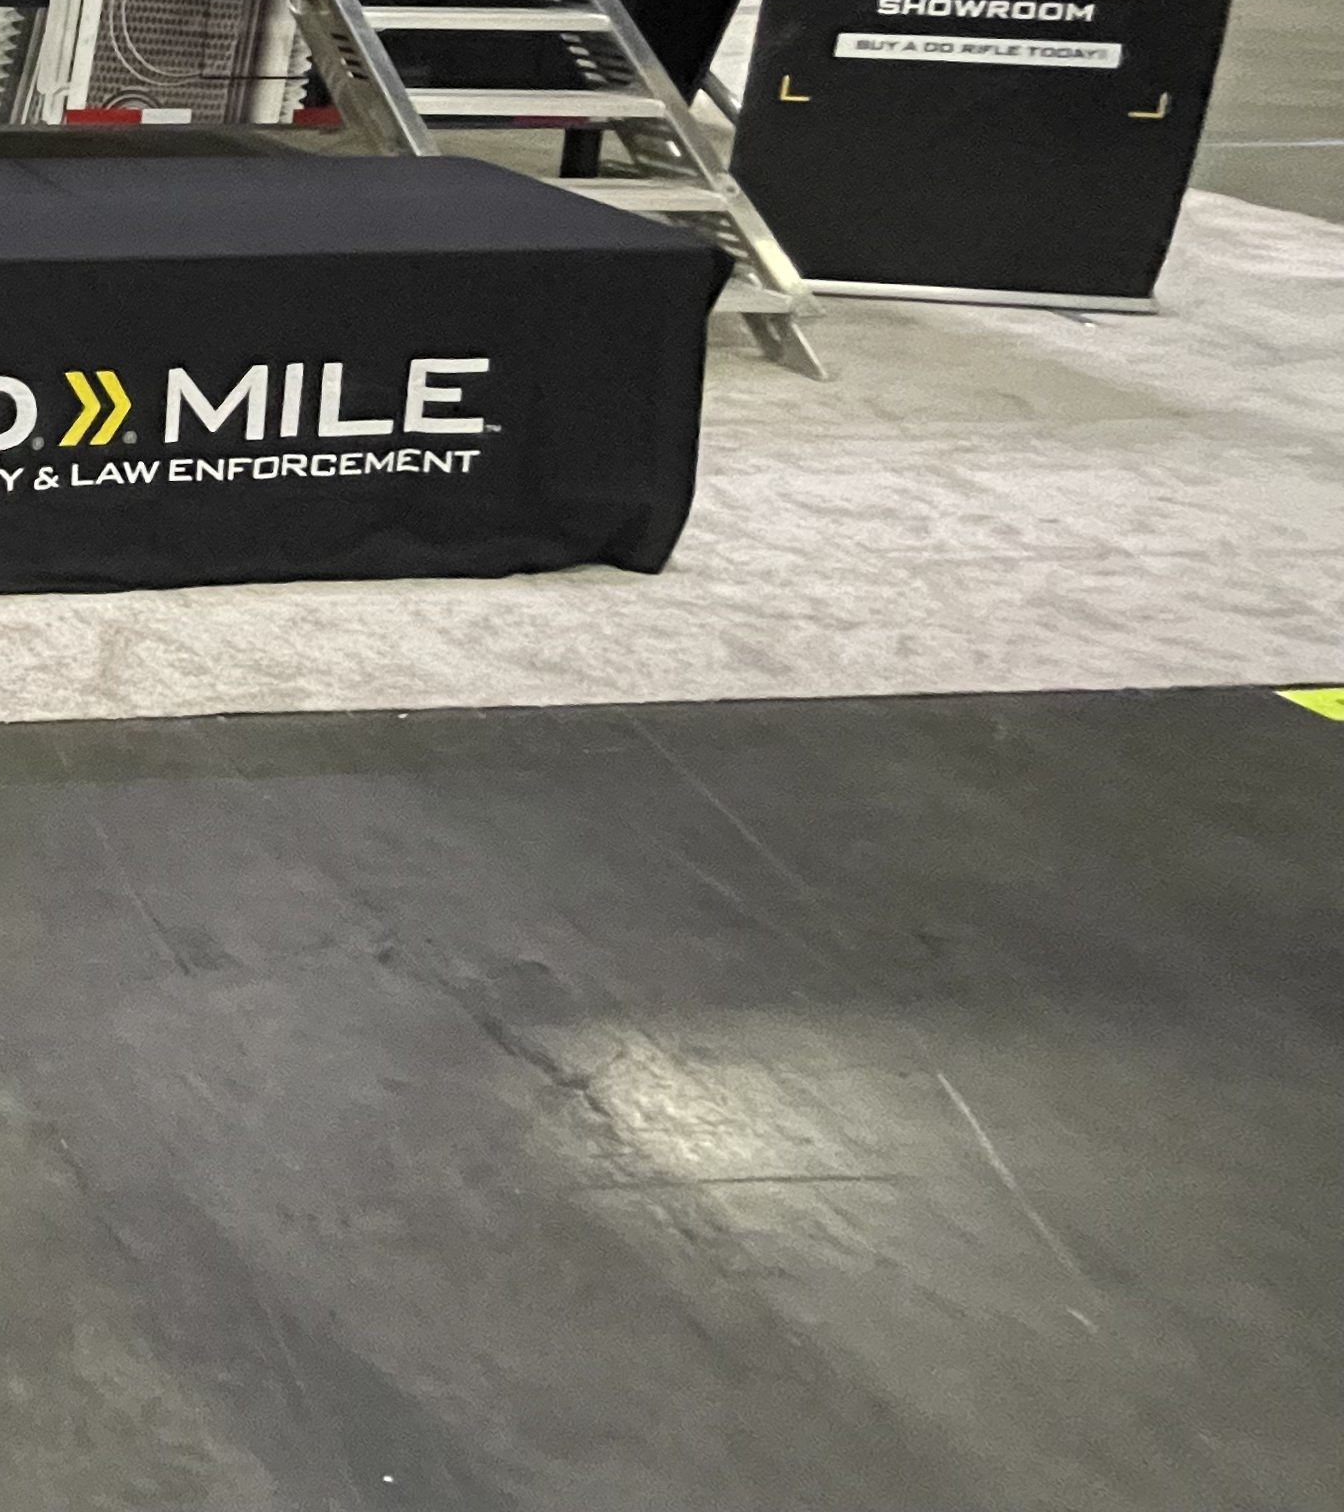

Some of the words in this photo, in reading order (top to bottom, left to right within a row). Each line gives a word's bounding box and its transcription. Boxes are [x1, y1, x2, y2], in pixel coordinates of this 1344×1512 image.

[855, 38, 899, 51] BUY
[902, 40, 918, 52] A
[959, 43, 1020, 57] RIFLE
[164, 357, 491, 444] MILE
[33, 466, 60, 491] &
[70, 460, 159, 487] LAW
[168, 448, 481, 482] ENFORCEMENT
